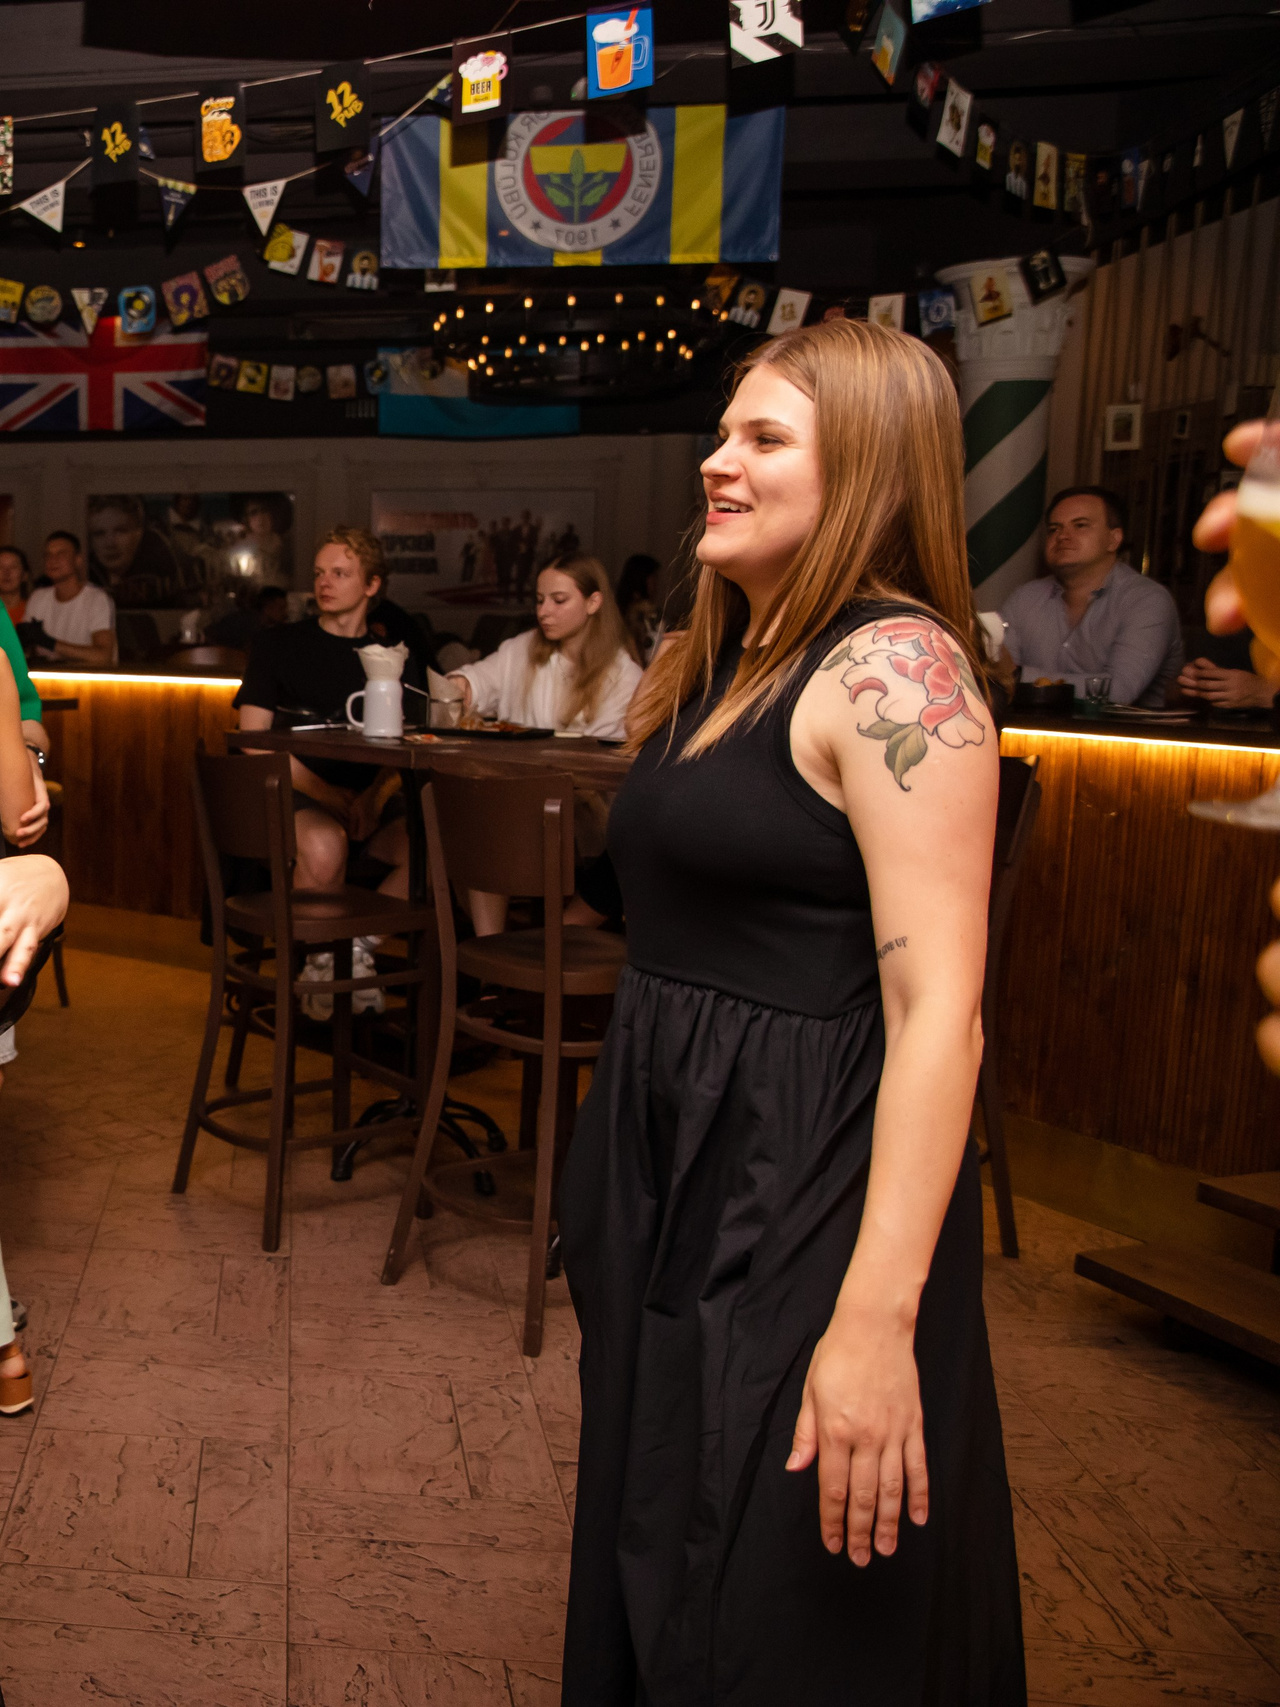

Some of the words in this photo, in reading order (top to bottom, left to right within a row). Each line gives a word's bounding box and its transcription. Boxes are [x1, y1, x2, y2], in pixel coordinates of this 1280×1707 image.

[470, 80, 492, 96] BEER
[326, 80, 358, 120] 12
[101, 121, 127, 155] 12
[249, 187, 268, 200] THIS
[269, 185, 279, 197] IS
[894, 935, 908, 948] UP
